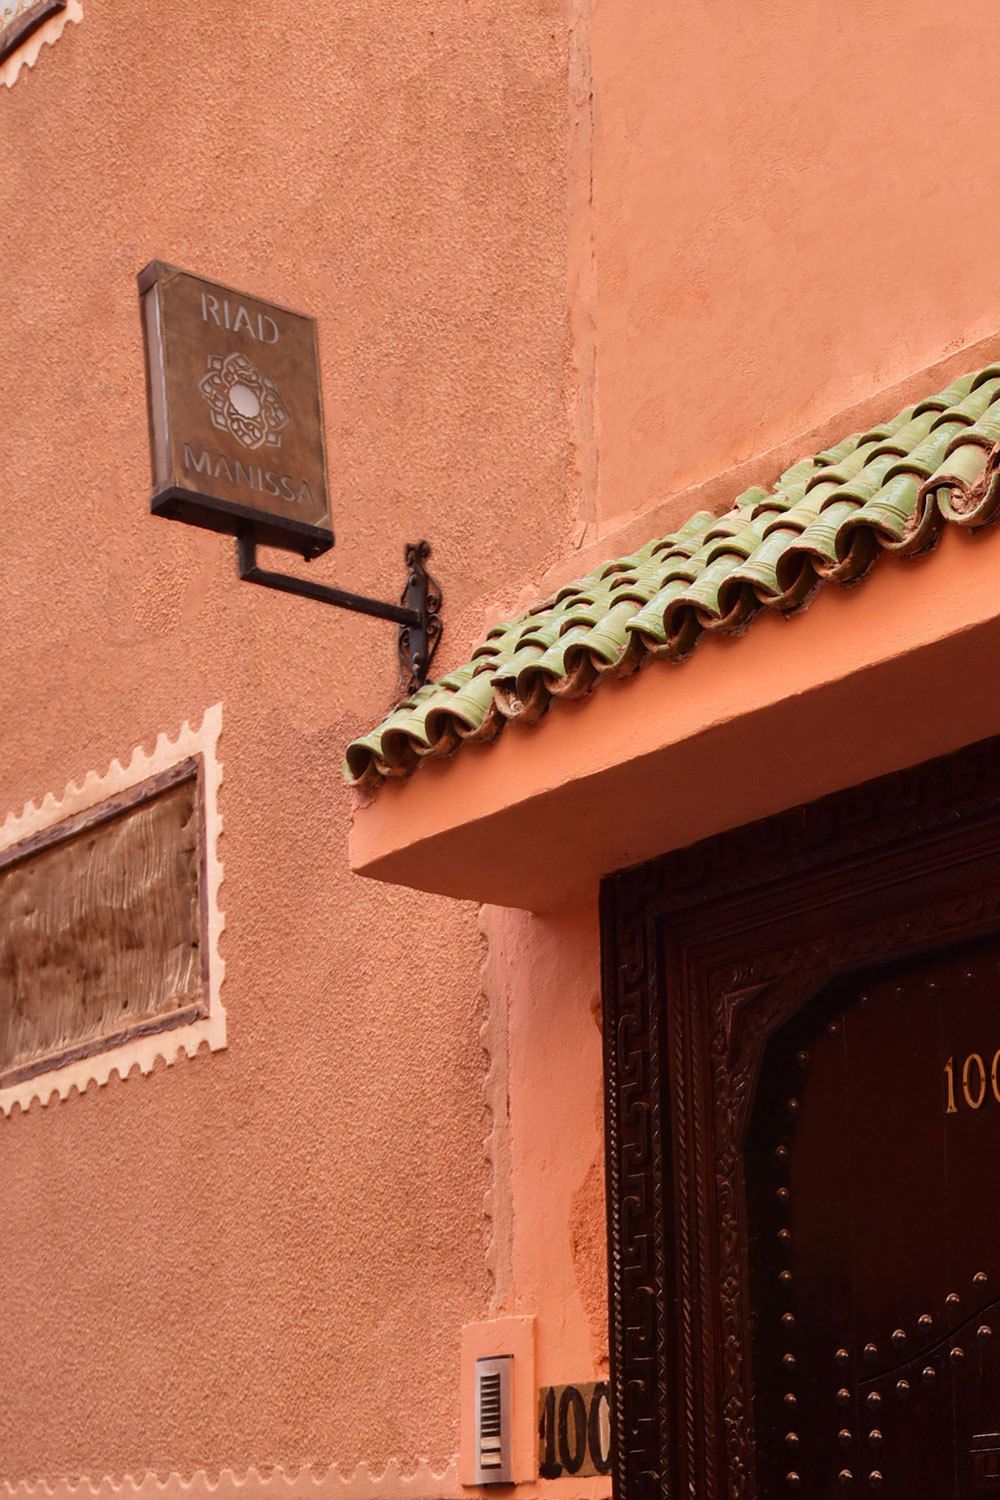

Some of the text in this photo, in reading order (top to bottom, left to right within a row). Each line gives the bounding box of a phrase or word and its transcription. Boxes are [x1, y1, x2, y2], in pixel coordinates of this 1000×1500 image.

[200, 292, 280, 344] RIAD
[184, 443, 316, 506] MANISSA
[538, 1381, 613, 1480] 100
